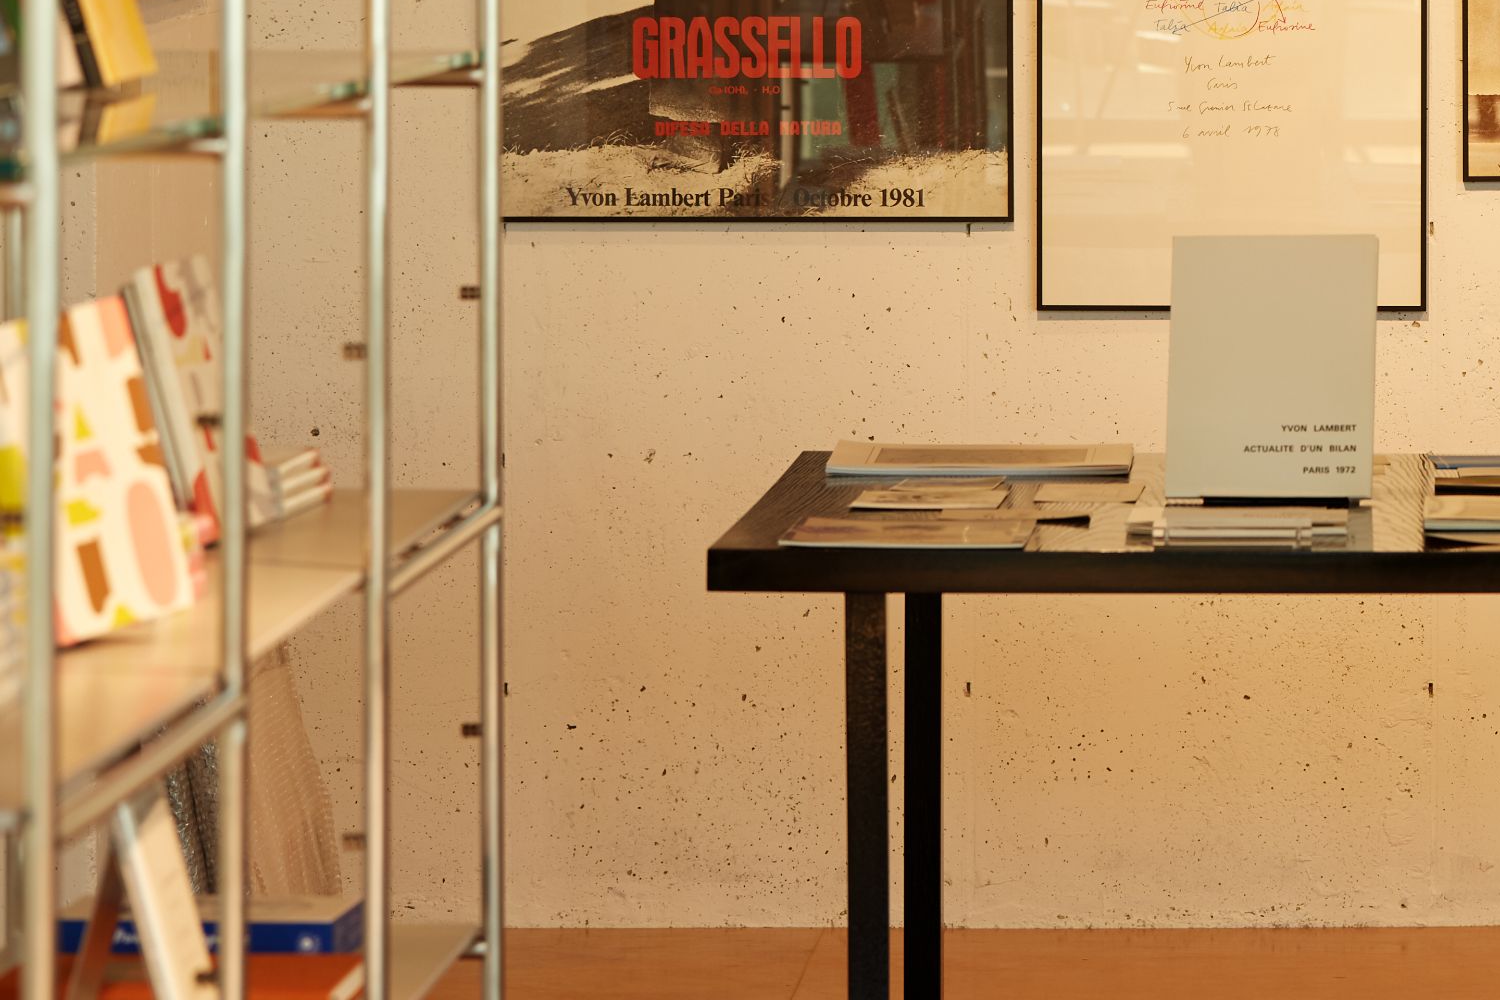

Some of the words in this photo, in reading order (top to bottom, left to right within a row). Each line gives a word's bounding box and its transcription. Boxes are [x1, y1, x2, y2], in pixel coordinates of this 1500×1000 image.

[632, 16, 862, 79] GRASSELLO
[655, 121, 711, 136] DIFESA
[720, 121, 769, 136] DELLA
[780, 121, 842, 136] NATURA
[566, 187, 618, 207] Yvon
[624, 187, 711, 207] Lambert
[794, 187, 872, 207] Octobre
[880, 188, 926, 207] 1981
[1281, 424, 1308, 432] YVON
[1313, 424, 1357, 432] LAMBERT
[1243, 445, 1294, 453] ACTUALITE
[1303, 466, 1330, 474] PARIS
[1335, 466, 1356, 474] 1972
